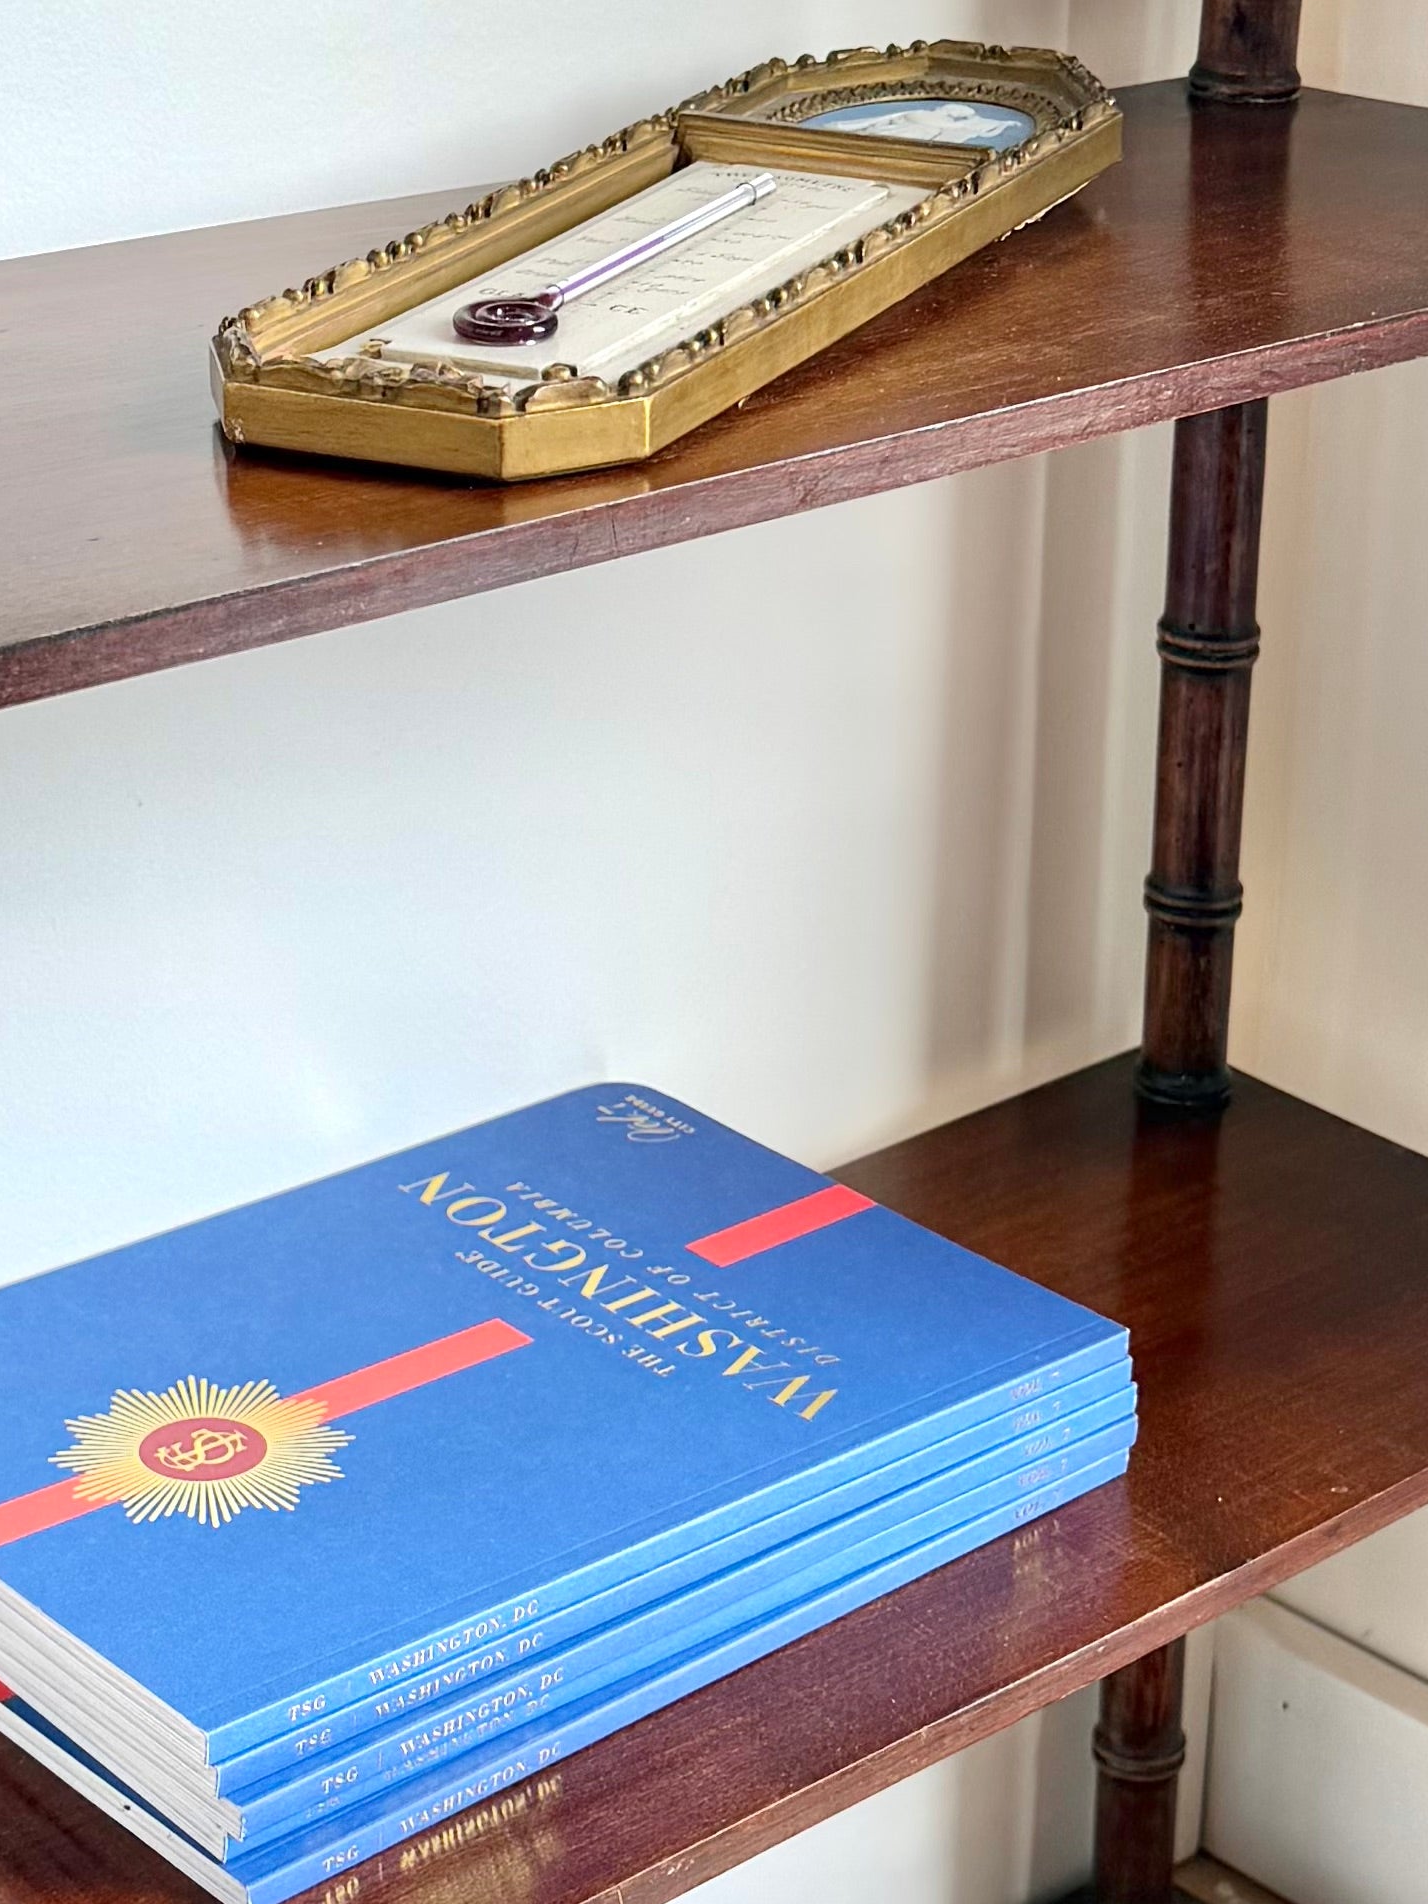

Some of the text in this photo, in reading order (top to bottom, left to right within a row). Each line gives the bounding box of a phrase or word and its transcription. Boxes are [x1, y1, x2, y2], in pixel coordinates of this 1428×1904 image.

[397, 1171, 839, 1422] WASHINGTON
[505, 1181, 840, 1365] DISTRICT OF COLUMBIA
[537, 1297, 624, 1345] SCOUT
[621, 1343, 676, 1377] THE
[288, 1695, 326, 1722] TSG
[512, 1599, 539, 1623] DC
[295, 1728, 331, 1756] TSG
[518, 1632, 544, 1654] DC
[321, 1766, 359, 1795] TSG
[540, 1667, 564, 1690] DC
[322, 1845, 360, 1872] TSG
[538, 1742, 562, 1764] DC
